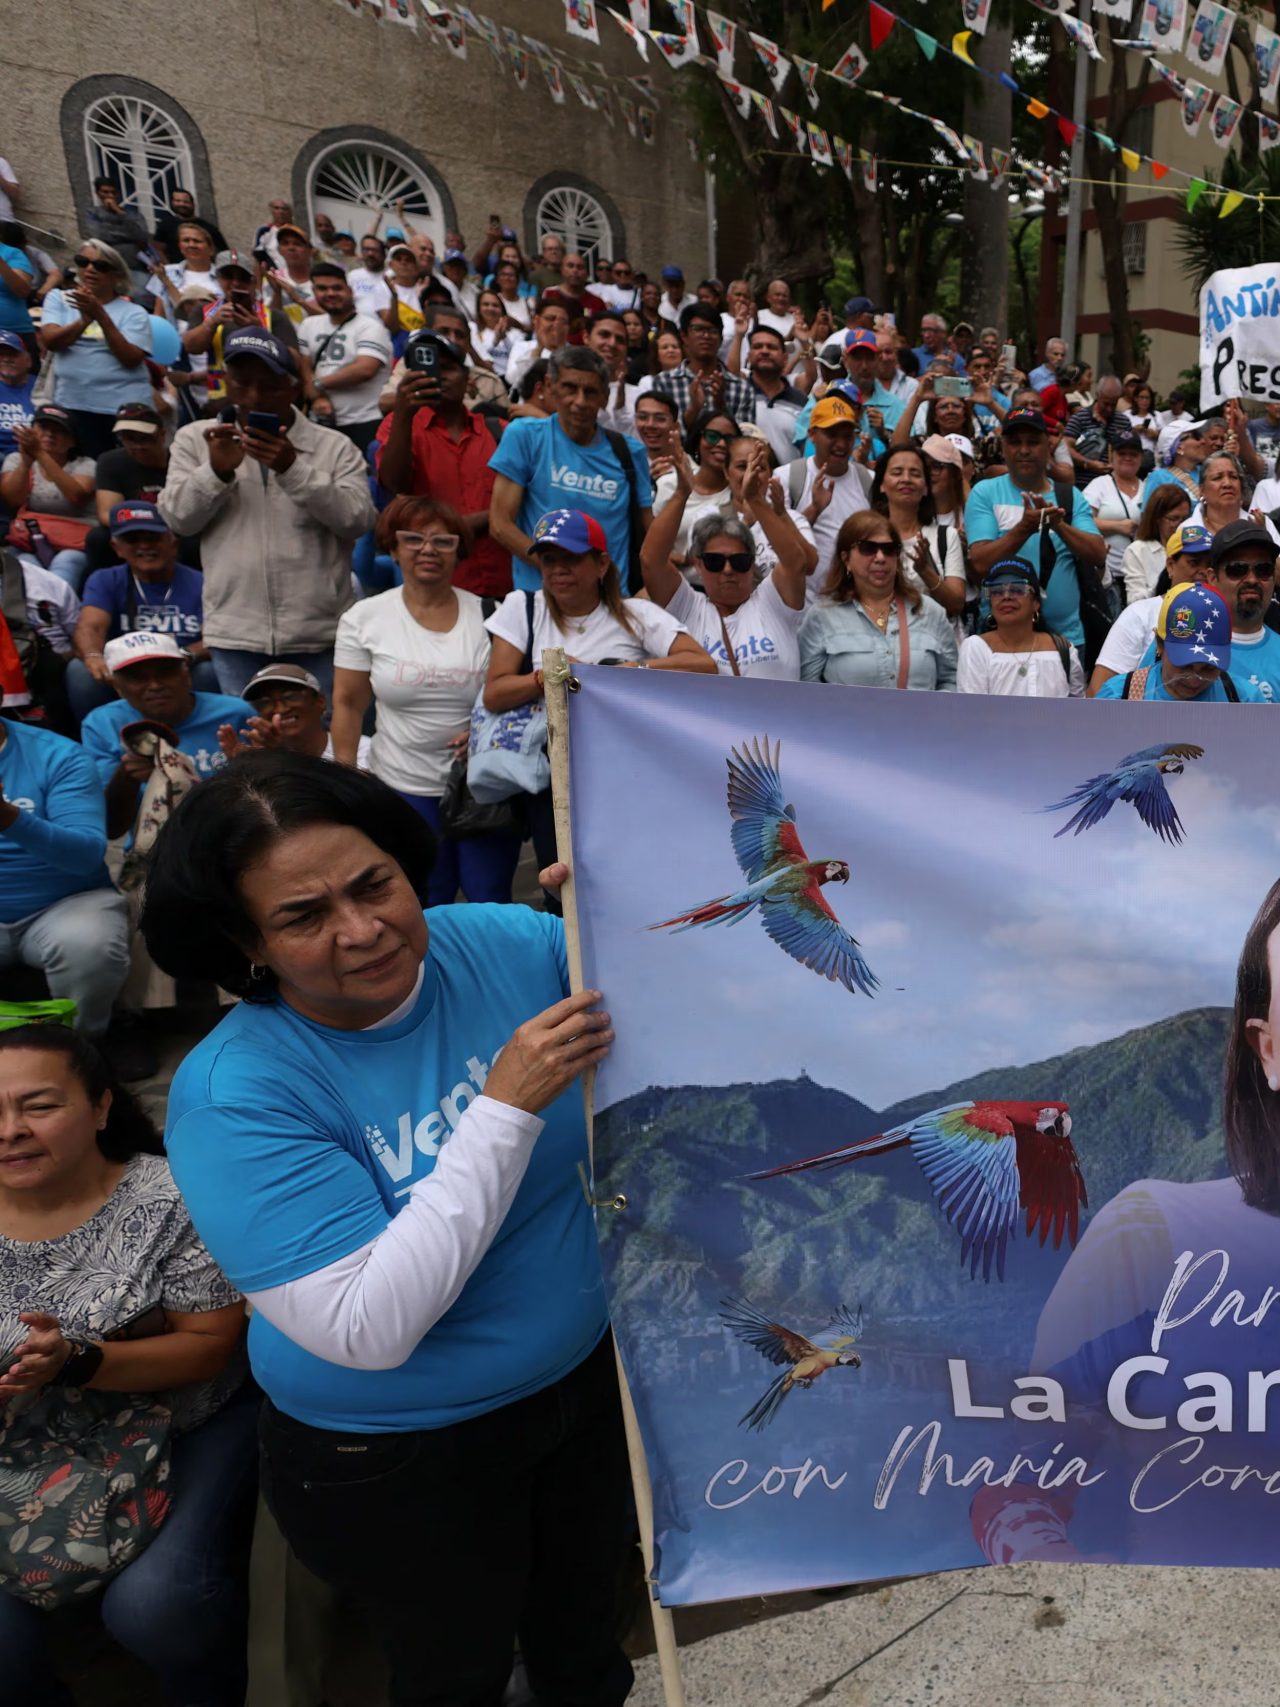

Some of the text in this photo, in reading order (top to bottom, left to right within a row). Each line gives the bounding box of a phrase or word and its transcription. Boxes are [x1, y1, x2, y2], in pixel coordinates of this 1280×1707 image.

[0, 403, 22, 413] ON
[551, 465, 618, 494] Vente
[703, 634, 775, 661] Vente
[366, 1046, 505, 1183] Vent
[948, 1358, 1067, 1423] La
[704, 1458, 847, 1510] con
